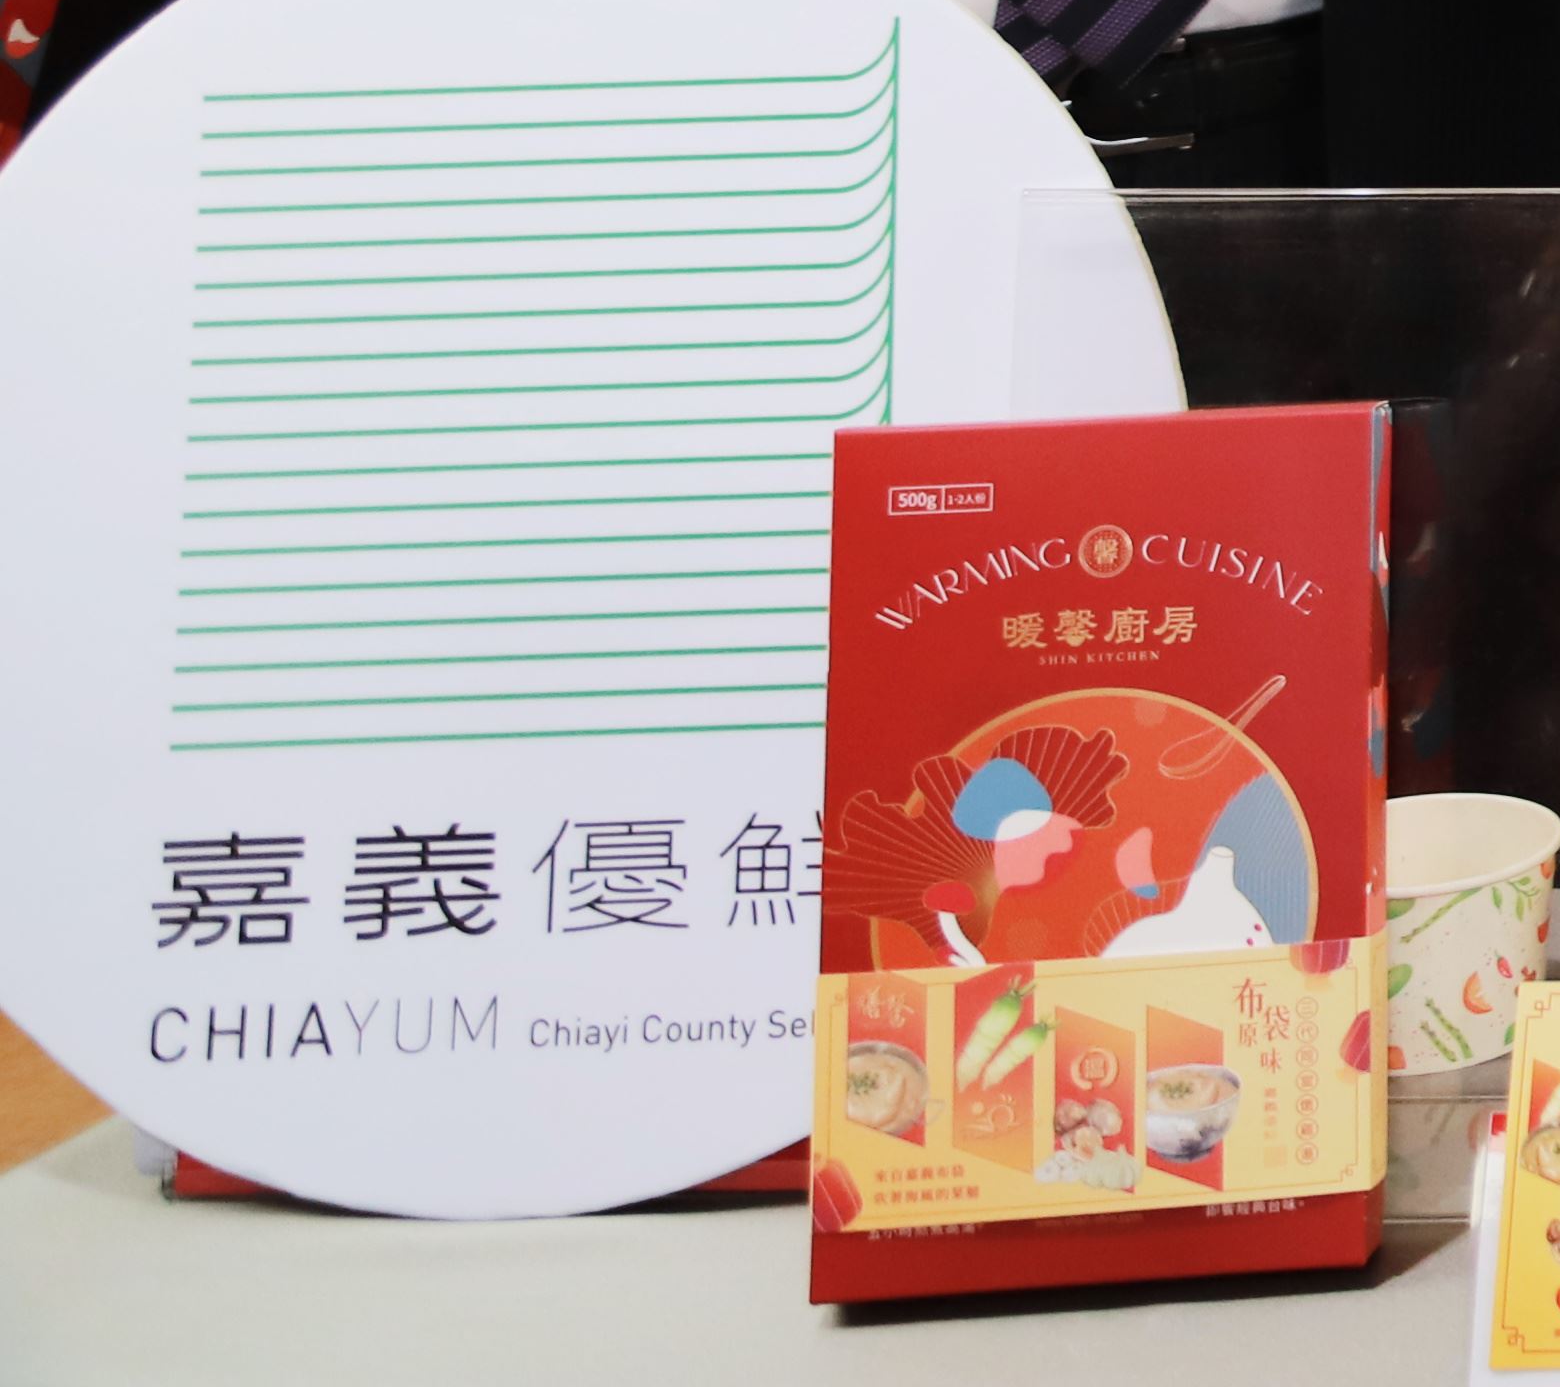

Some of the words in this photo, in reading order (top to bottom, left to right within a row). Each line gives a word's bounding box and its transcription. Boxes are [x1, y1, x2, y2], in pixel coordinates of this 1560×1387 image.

[897, 491, 938, 512] 500g
[874, 537, 1072, 630] WARMING
[1140, 533, 1325, 616] CUISINE
[1001, 605, 1199, 650] 暖馨廚房
[1037, 652, 1079, 666] SHIN
[1086, 649, 1162, 665] KITCHEN
[152, 811, 822, 949] 嘉義優鮮
[149, 995, 500, 1064] CHIAYUM
[528, 1009, 629, 1053] Chiayi
[641, 1011, 757, 1049] County
[767, 1008, 818, 1040] Sel
